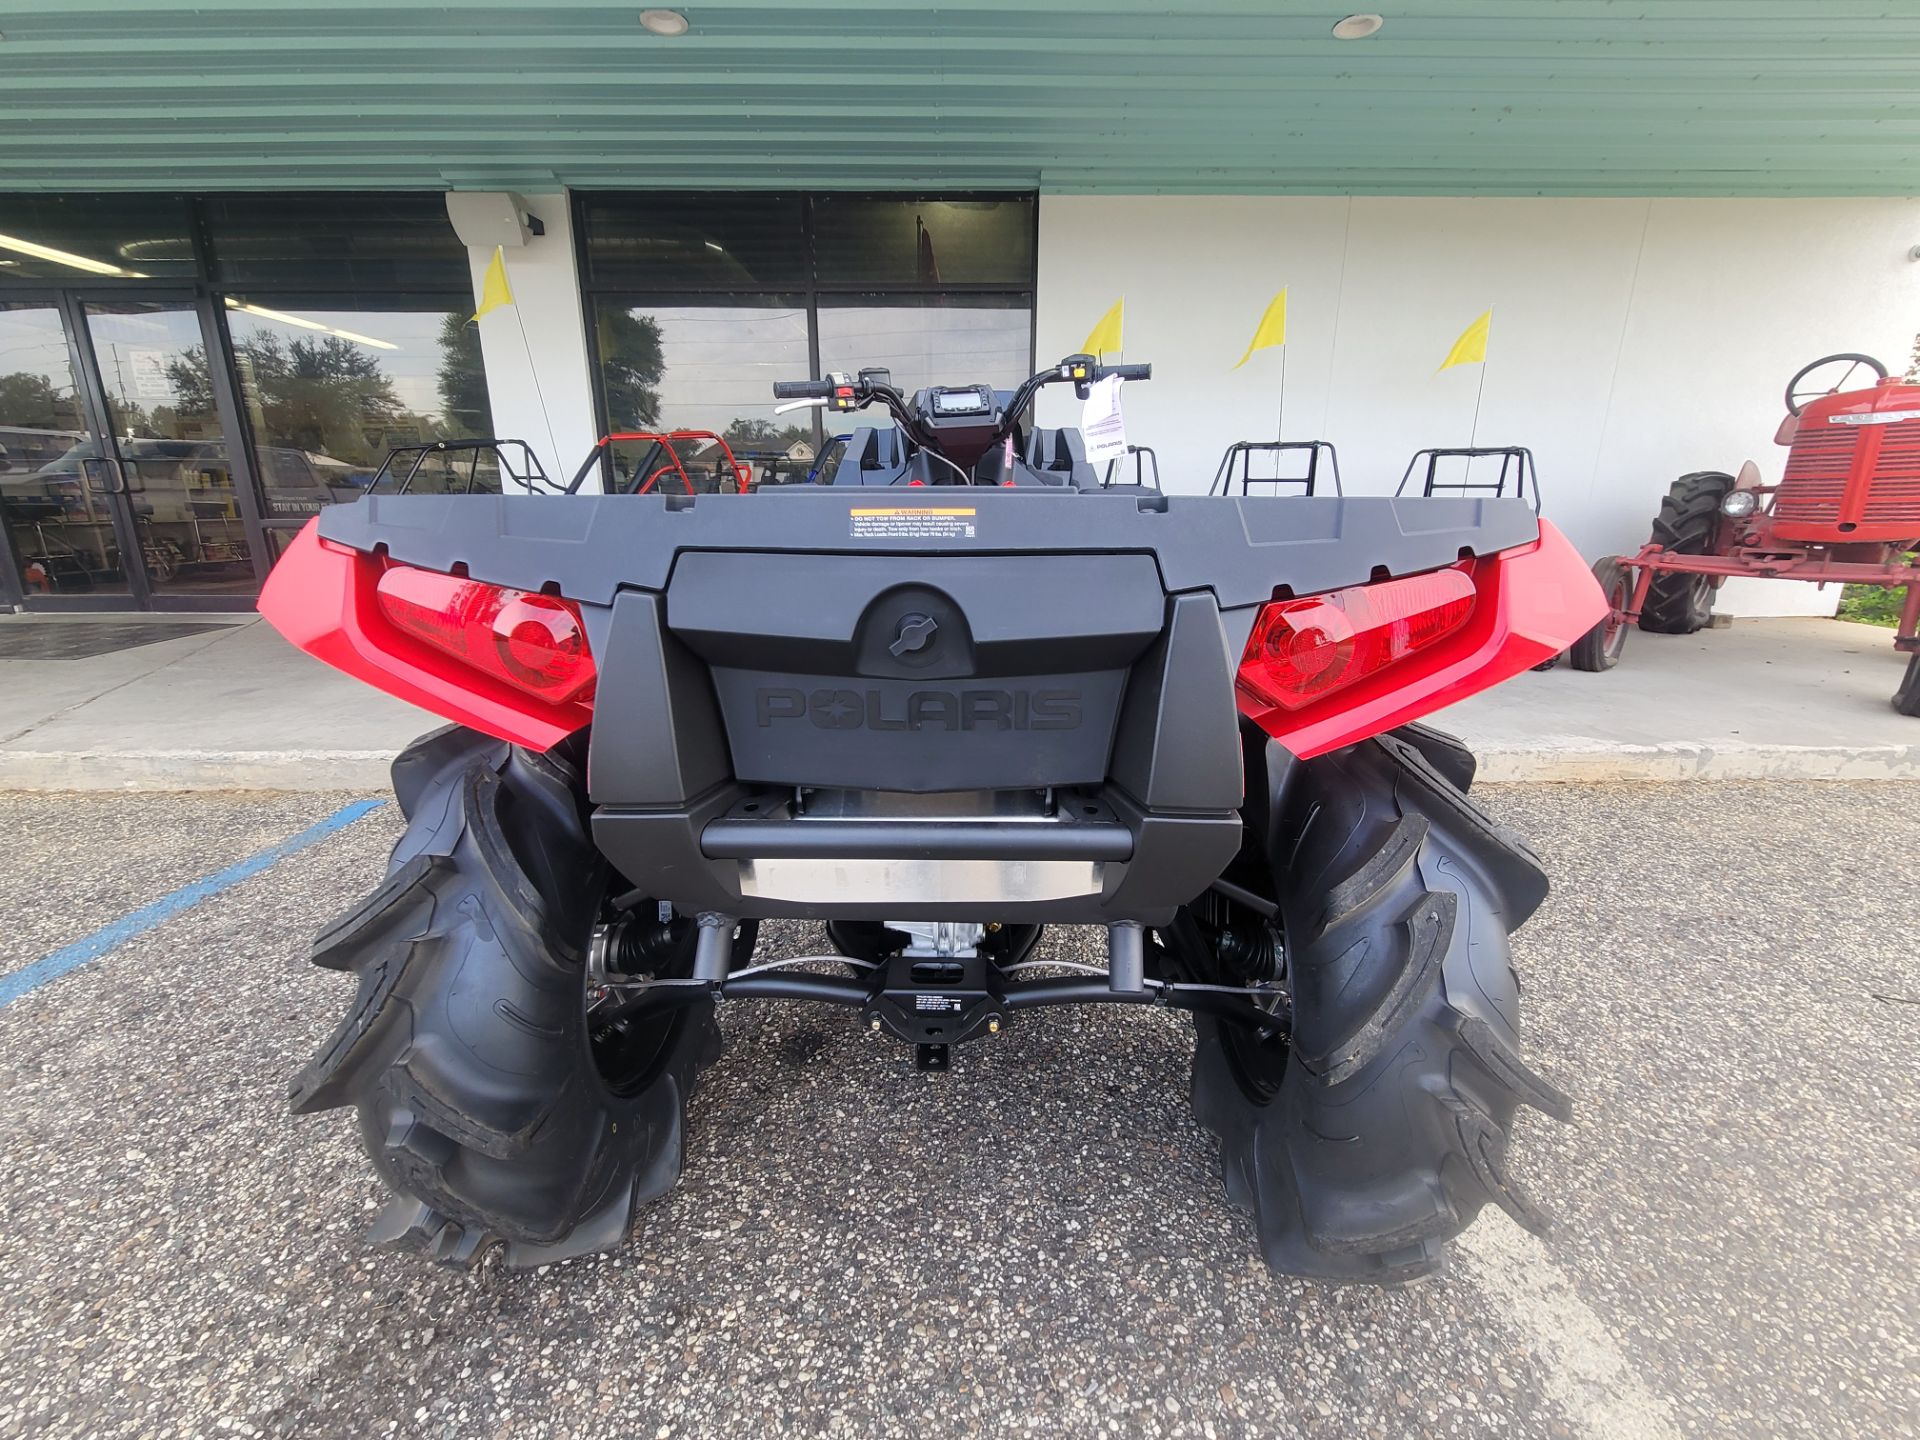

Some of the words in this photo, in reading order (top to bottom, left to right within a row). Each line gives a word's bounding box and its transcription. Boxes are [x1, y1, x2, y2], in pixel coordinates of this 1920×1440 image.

[272, 502, 291, 512] STAY
[292, 502, 300, 512] IN
[301, 502, 320, 512] YOUR
[754, 687, 1083, 732] POLARIS
